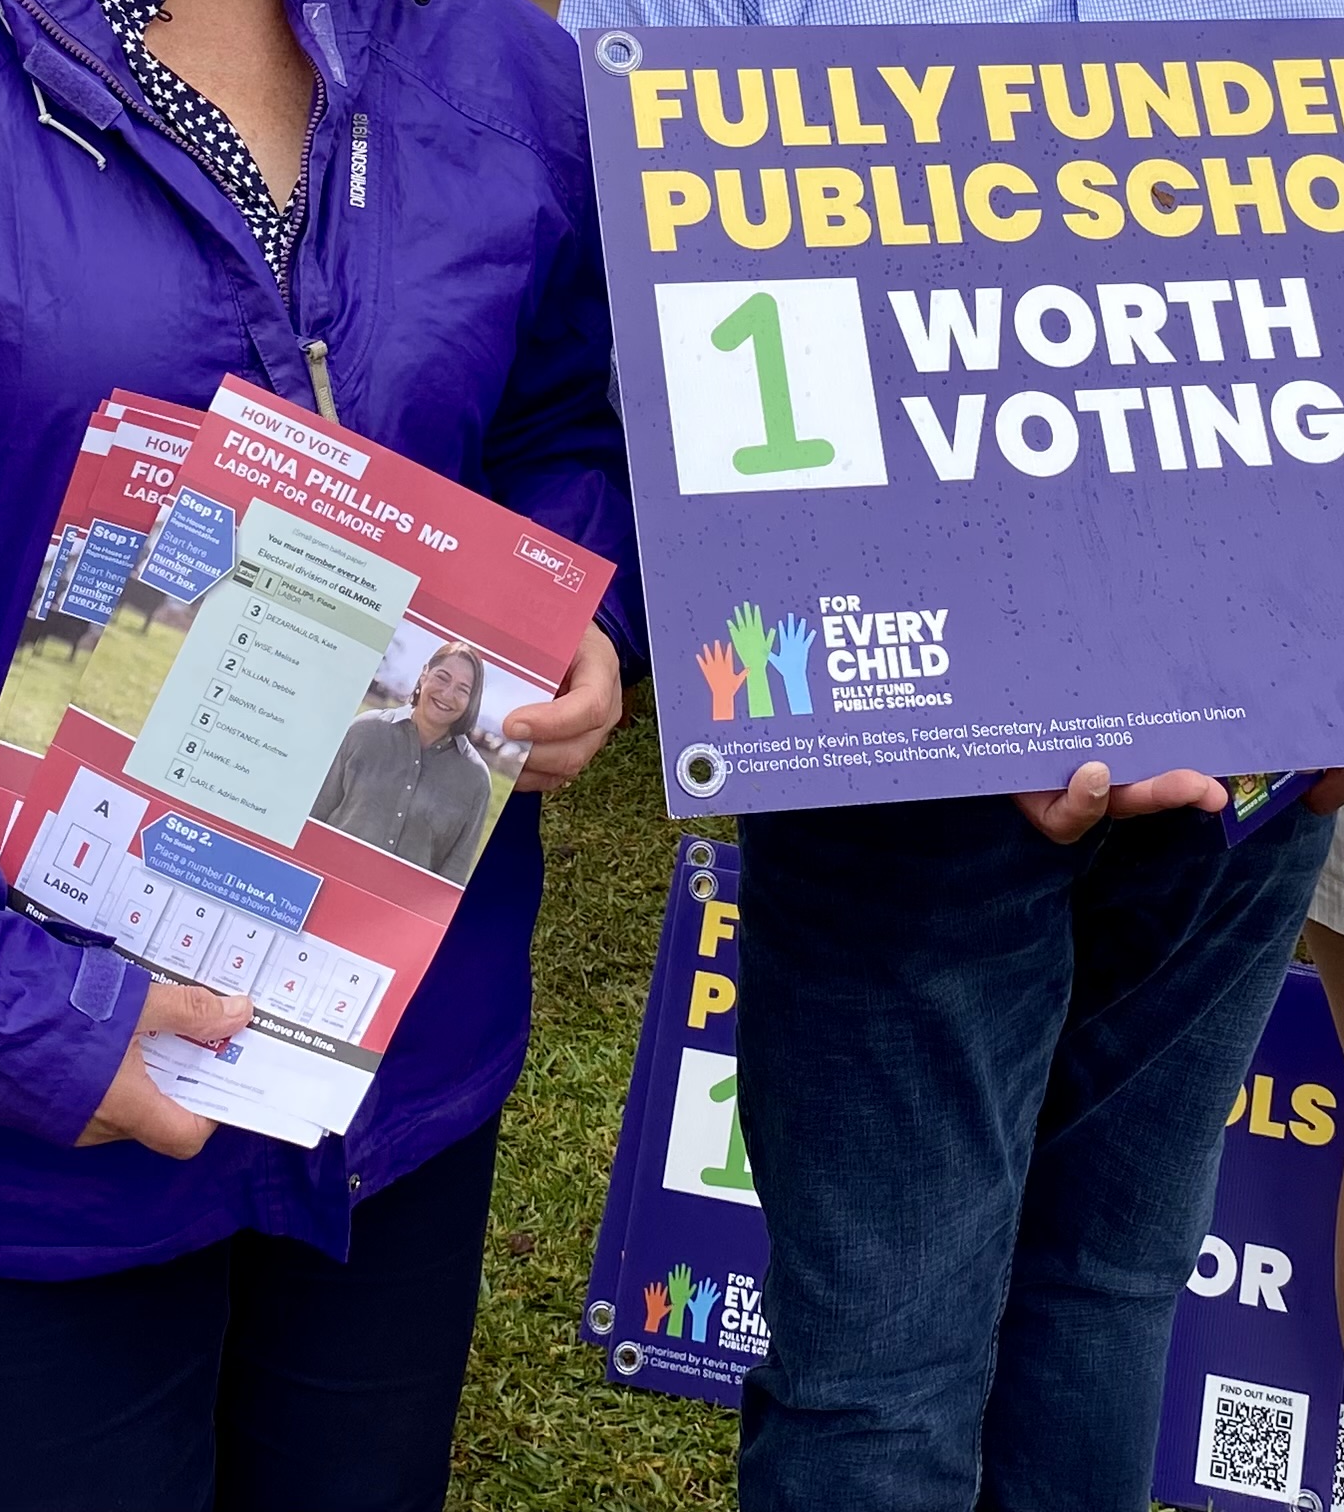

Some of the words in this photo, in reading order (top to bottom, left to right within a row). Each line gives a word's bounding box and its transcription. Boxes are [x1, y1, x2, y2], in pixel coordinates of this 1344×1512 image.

[629, 66, 954, 148] FULLY
[350, 140, 367, 208] DIDRIKSONS
[642, 163, 1043, 251] PUBLIC
[887, 277, 1321, 373] WORTH
[709, 291, 835, 475] 1
[241, 405, 281, 433] HOW
[283, 425, 306, 443] TO
[309, 435, 351, 466] VOTE
[214, 454, 268, 488] LABOR
[274, 481, 307, 506] FOR
[311, 499, 386, 543] GILMORE
[223, 430, 297, 479] FIONA
[305, 468, 414, 533] PHILLIPS
[418, 526, 458, 553] MP
[520, 540, 565, 573] Labor
[820, 594, 861, 613] FOR
[822, 608, 948, 649] EVERY
[826, 644, 950, 683] CHILD
[831, 686, 875, 699] FULLY
[876, 682, 915, 696] FUND
[834, 698, 885, 713] PUBLIC
[886, 692, 952, 710] SCHOOLS
[795, 736, 814, 753] by
[817, 732, 858, 748] Kevin
[863, 729, 909, 745] Bates,
[912, 724, 967, 741] Federal
[971, 722, 1046, 738] Secretary,
[1050, 715, 1124, 733] Australian
[1128, 710, 1200, 727] Education
[1204, 707, 1245, 720] Union
[738, 753, 818, 773] Clarendon
[823, 751, 872, 767] Street,
[875, 744, 960, 763] Southbank,
[963, 742, 1023, 757] Victoria,
[1027, 736, 1092, 752] Australia
[1096, 732, 1132, 747] 3006
[728, 1273, 755, 1288] FOR
[720, 1331, 745, 1343] FULLY
[721, 1309, 771, 1338] CHI
[639, 1343, 687, 1361] uthorised
[688, 1354, 700, 1366] by
[702, 1358, 729, 1370] Kevin
[719, 1340, 750, 1352] PUBLIC
[650, 1358, 700, 1376] Clarendon
[702, 1369, 732, 1384] Street,
[1221, 1384, 1242, 1395] FIND
[1245, 1389, 1264, 1400] OUT
[1266, 1394, 1293, 1406] MORE
